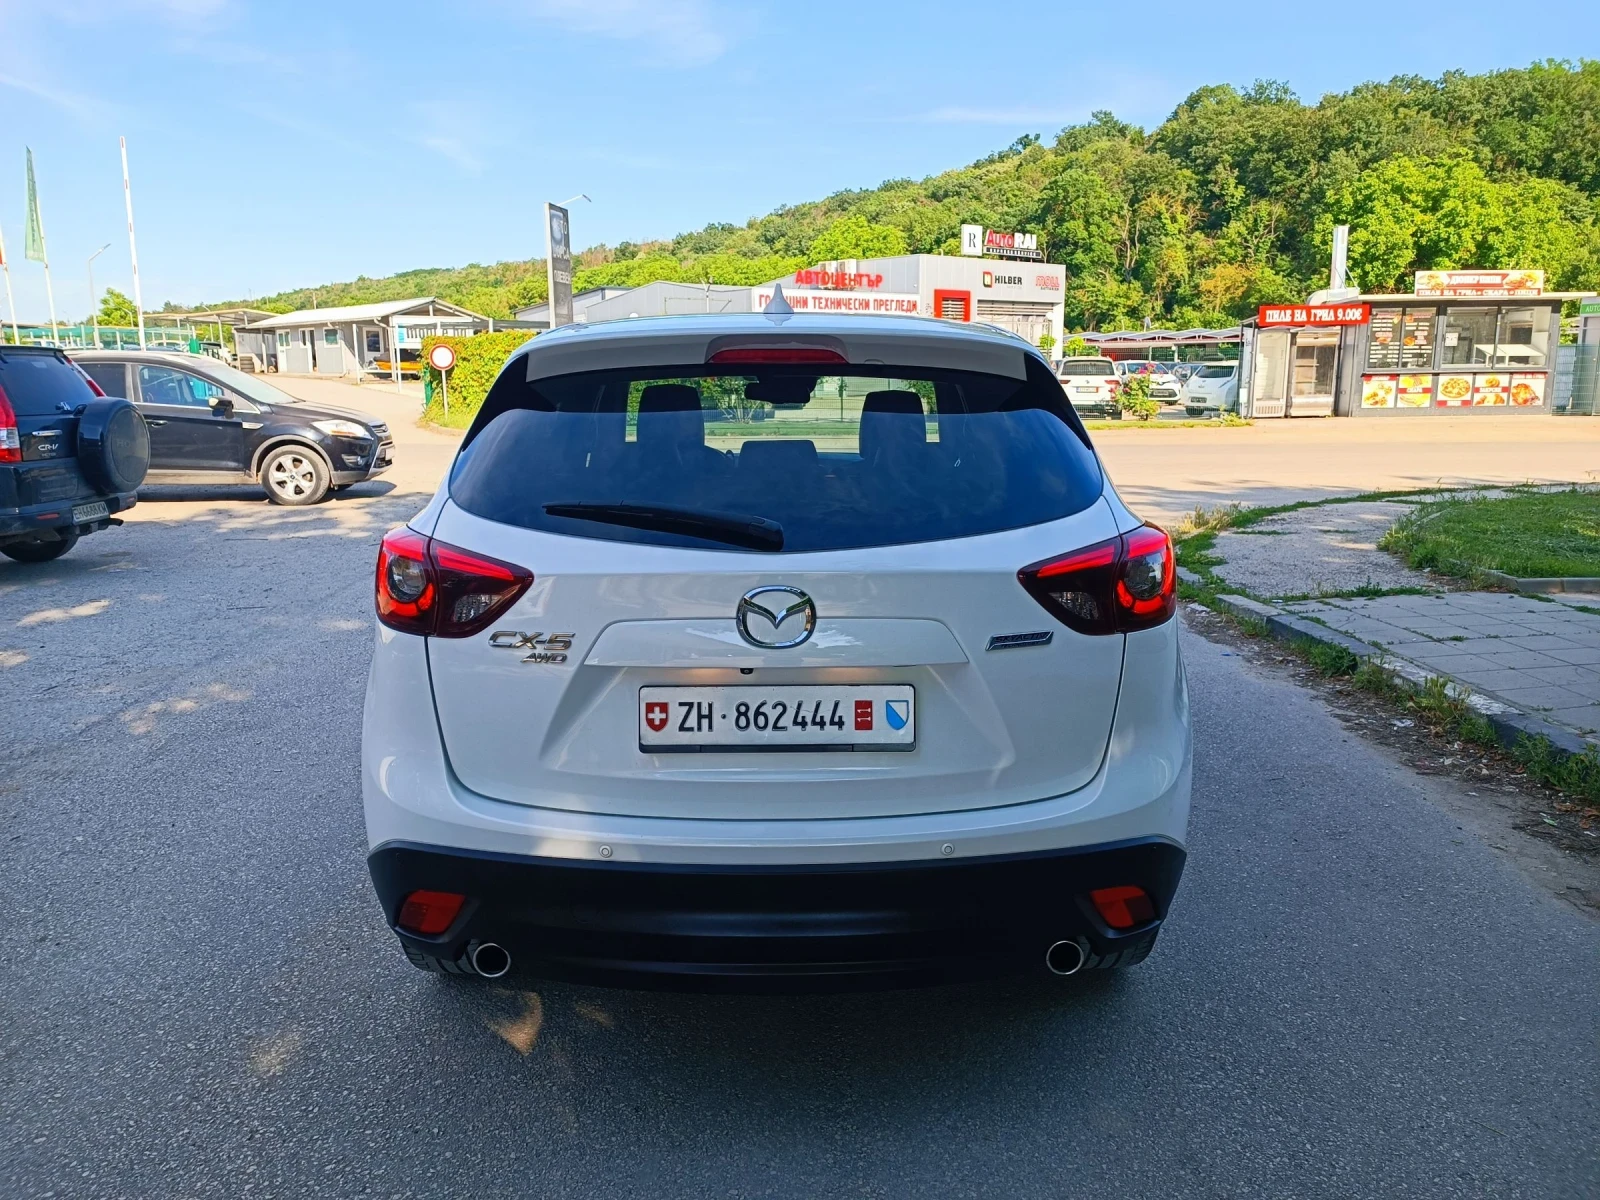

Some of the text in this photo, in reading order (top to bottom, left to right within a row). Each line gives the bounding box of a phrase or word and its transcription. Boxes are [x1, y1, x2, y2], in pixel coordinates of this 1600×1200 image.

[968, 232, 977, 248] R
[795, 269, 883, 288] АВТОЦЕНТЪР
[994, 275, 1023, 286] HILBER
[758, 294, 918, 313] ГОШНИ ТЕХНИЧЕСКИ ПРЕГЛЕДИ
[1265, 309, 1292, 322] ПИЛЕ
[1293, 309, 1307, 322] НА
[1310, 309, 1335, 321] ГРИЛ
[38, 443, 59, 451] CR-V
[488, 630, 576, 650] CX-5
[520, 652, 568, 664] AWD
